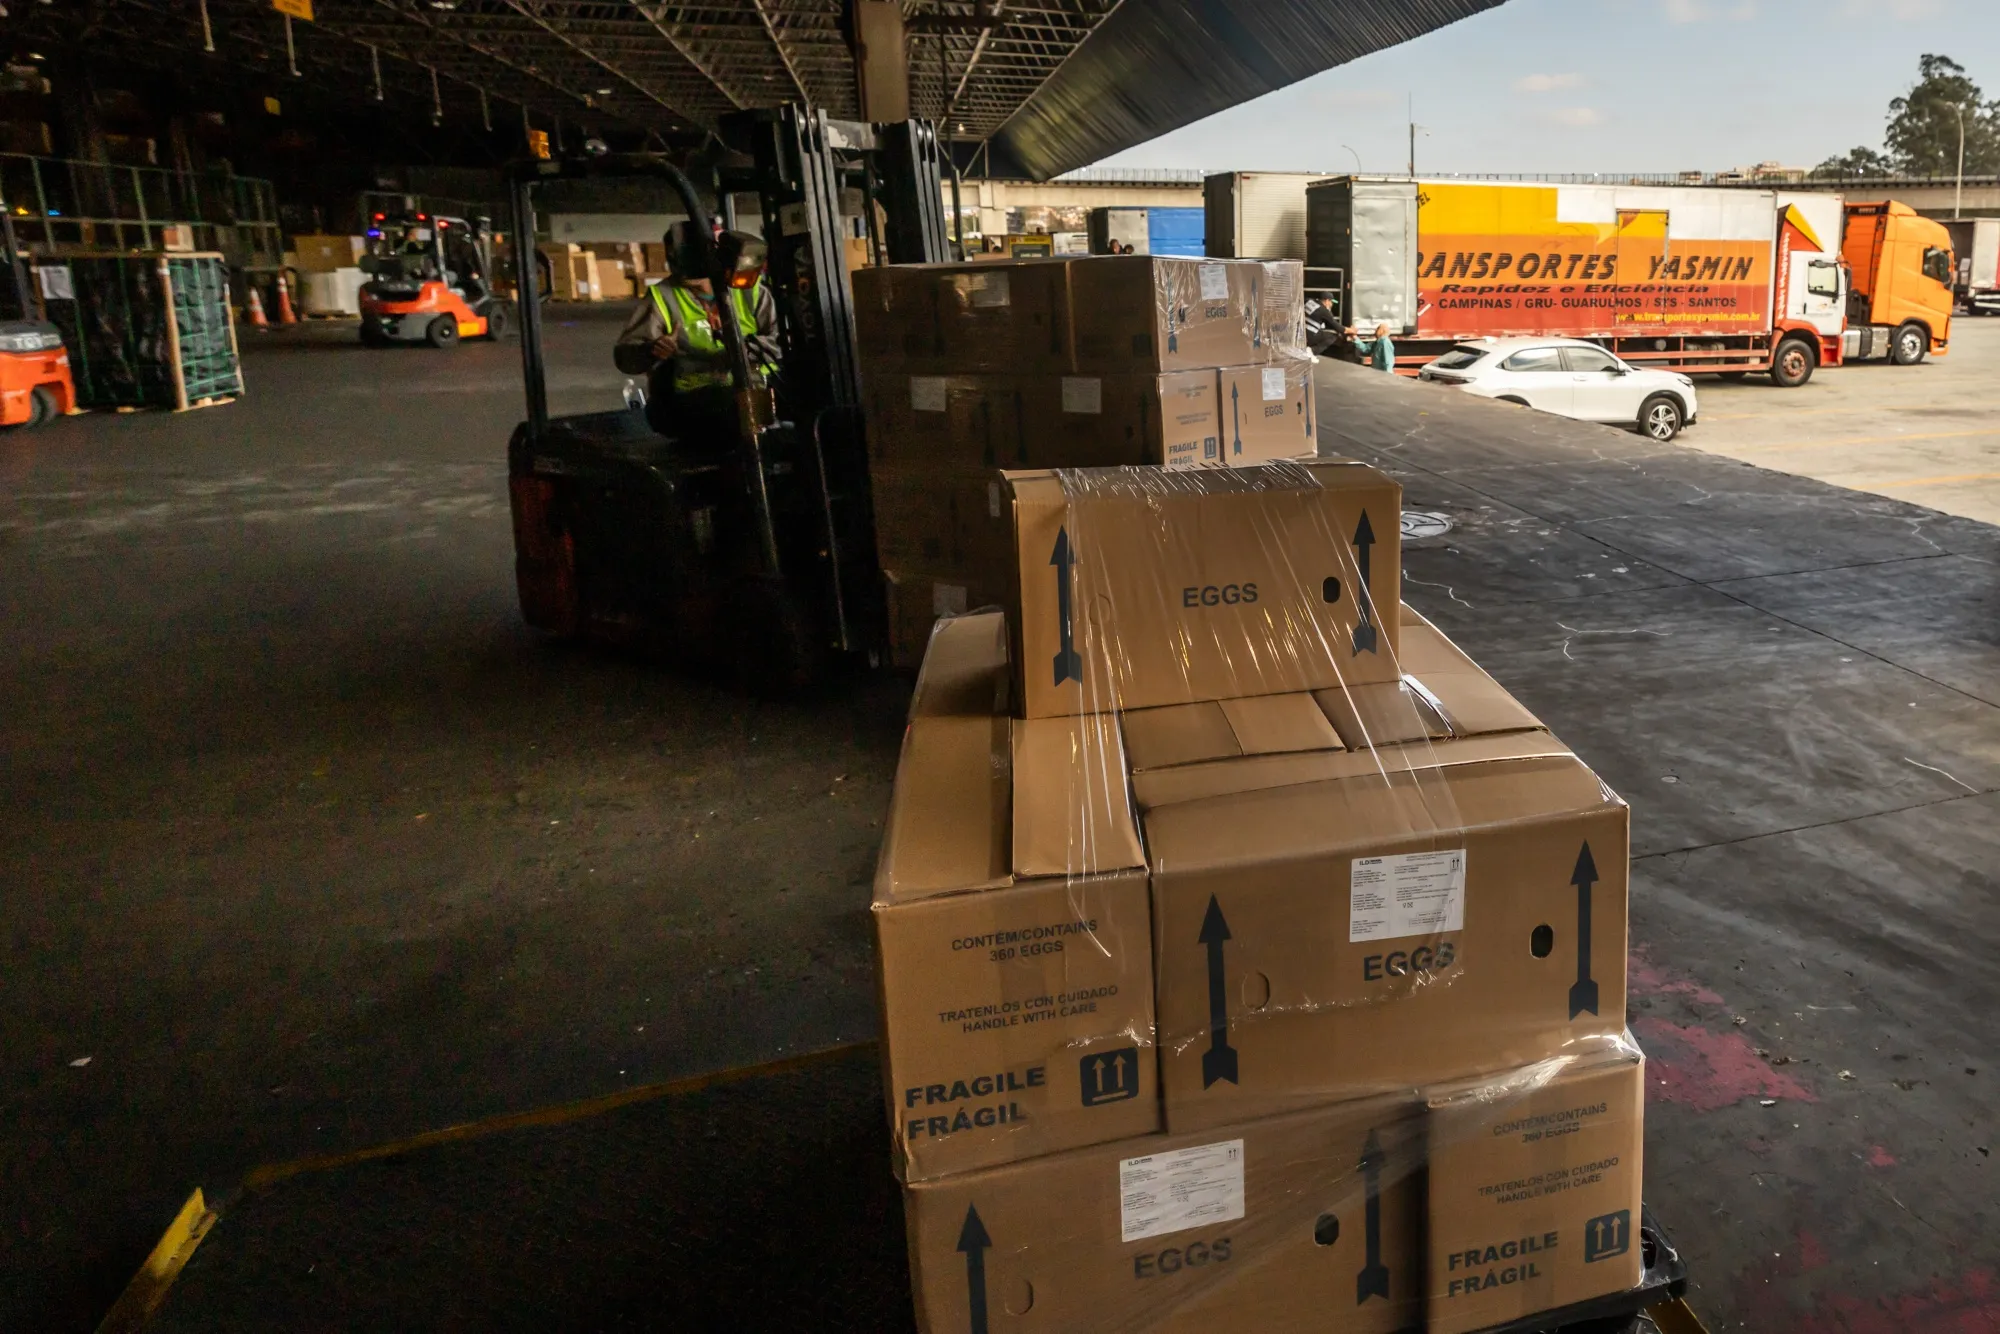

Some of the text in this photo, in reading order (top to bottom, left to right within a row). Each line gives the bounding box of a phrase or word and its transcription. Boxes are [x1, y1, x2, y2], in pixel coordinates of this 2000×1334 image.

[1648, 255, 1754, 281] YASMIN
[1439, 299, 1512, 309] CAMPINAS
[1561, 298, 1642, 308] GUARULHOS
[1688, 298, 1737, 308] SANTOS
[1441, 284, 1710, 296] Rapidez e Eficiência
[1205, 306, 1228, 319] EGGS
[1264, 404, 1284, 418] EGGS
[1168, 441, 1198, 455] FRAGILE
[1183, 583, 1258, 608] EGGS
[989, 940, 1064, 963] 360 EGGS
[1363, 942, 1455, 982] EGGS
[938, 985, 1119, 1024] TRATENLOS CON CUIDADO
[962, 1002, 1097, 1033] HANDLE WITH CARE
[904, 1066, 1047, 1109] FRAGILE
[907, 1101, 1028, 1141] FRÁGIL
[1544, 1121, 1581, 1139] EGGS
[1477, 1156, 1620, 1197] TRATENLOS CON CUIDADO
[1496, 1172, 1603, 1205] HANDLE WITH CARE
[1133, 1237, 1232, 1279] EGGS
[1448, 1231, 1559, 1271] FRAGILE
[1448, 1262, 1543, 1298] FRÁGIL
